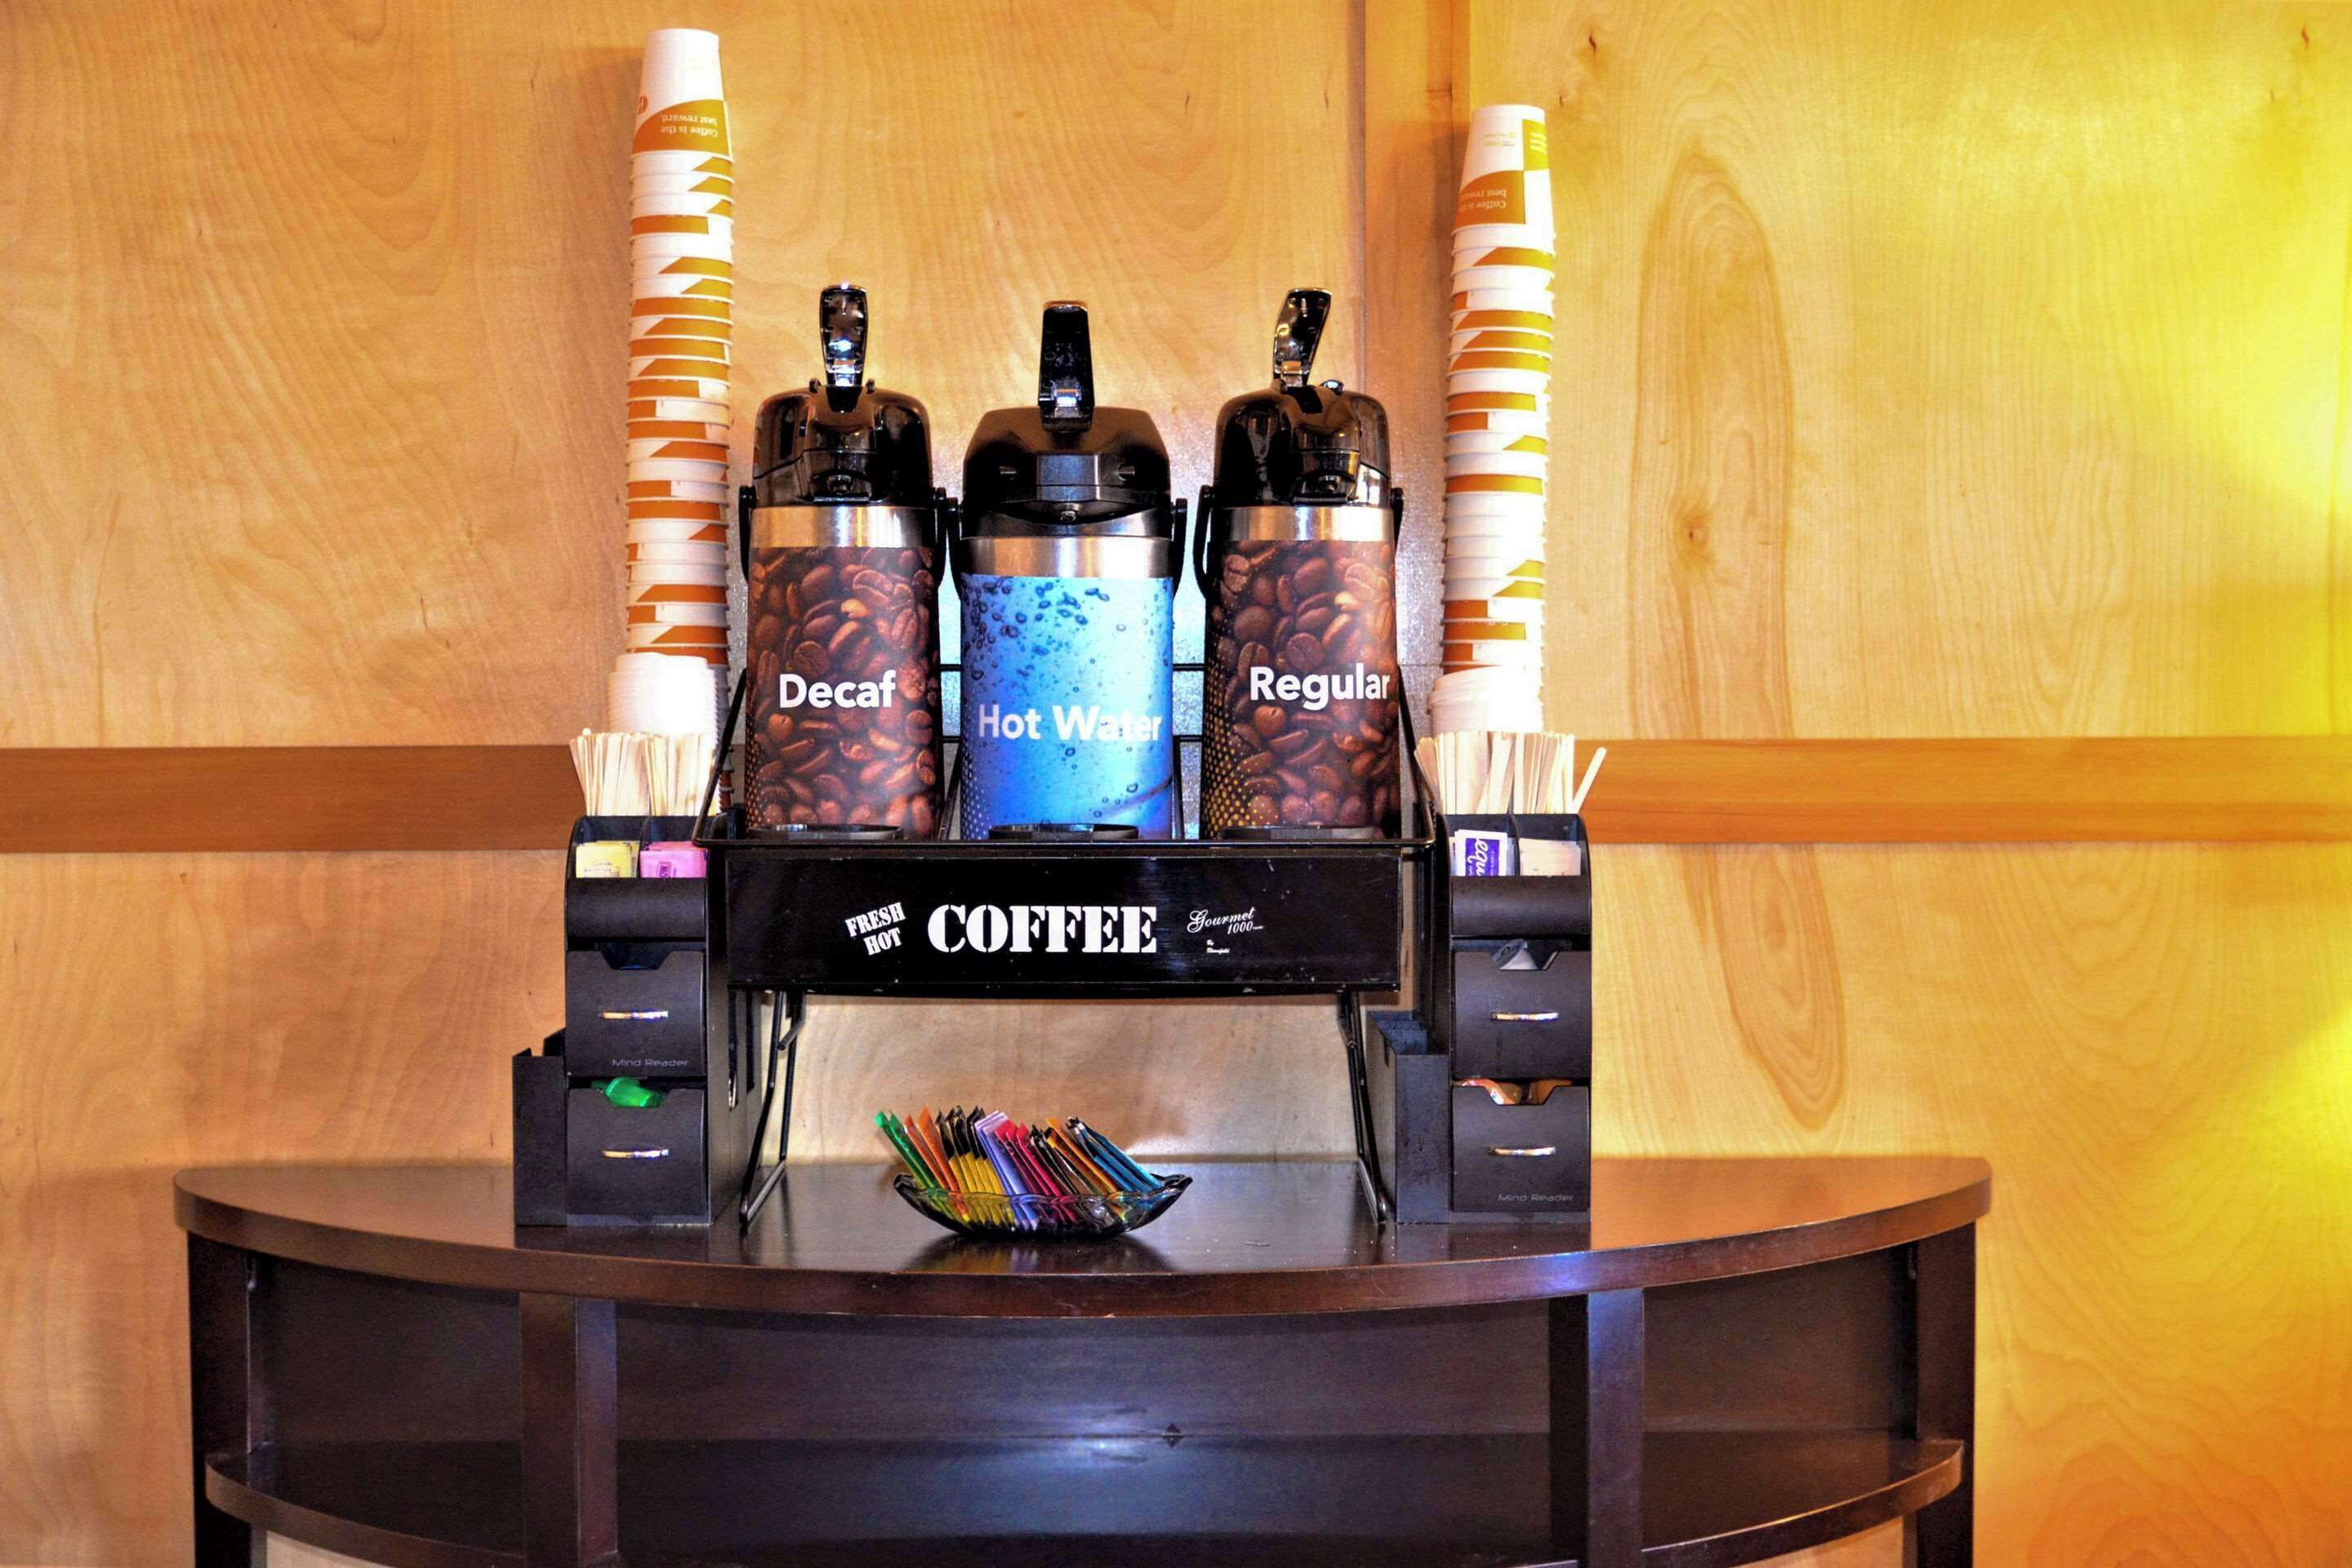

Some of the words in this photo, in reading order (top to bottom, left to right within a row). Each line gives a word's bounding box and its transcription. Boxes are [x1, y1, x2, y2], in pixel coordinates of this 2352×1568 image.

[661, 126, 677, 135] the
[679, 127, 688, 135] is
[690, 127, 718, 137] Coffee
[780, 670, 897, 708] Decaf
[1250, 662, 1390, 710] Regular
[979, 703, 1042, 740] Hot
[1052, 705, 1162, 742] Water
[1468, 838, 1488, 875] equ
[844, 902, 906, 938] FRESH
[928, 904, 1156, 953] COFFEE
[1187, 906, 1256, 933] Gourmet
[1227, 921, 1254, 935] 1000
[863, 928, 902, 956] HOT
[644, 1058, 688, 1067] Reader
[1498, 1194, 1527, 1202] Mind
[1530, 1194, 1574, 1202] Reader
